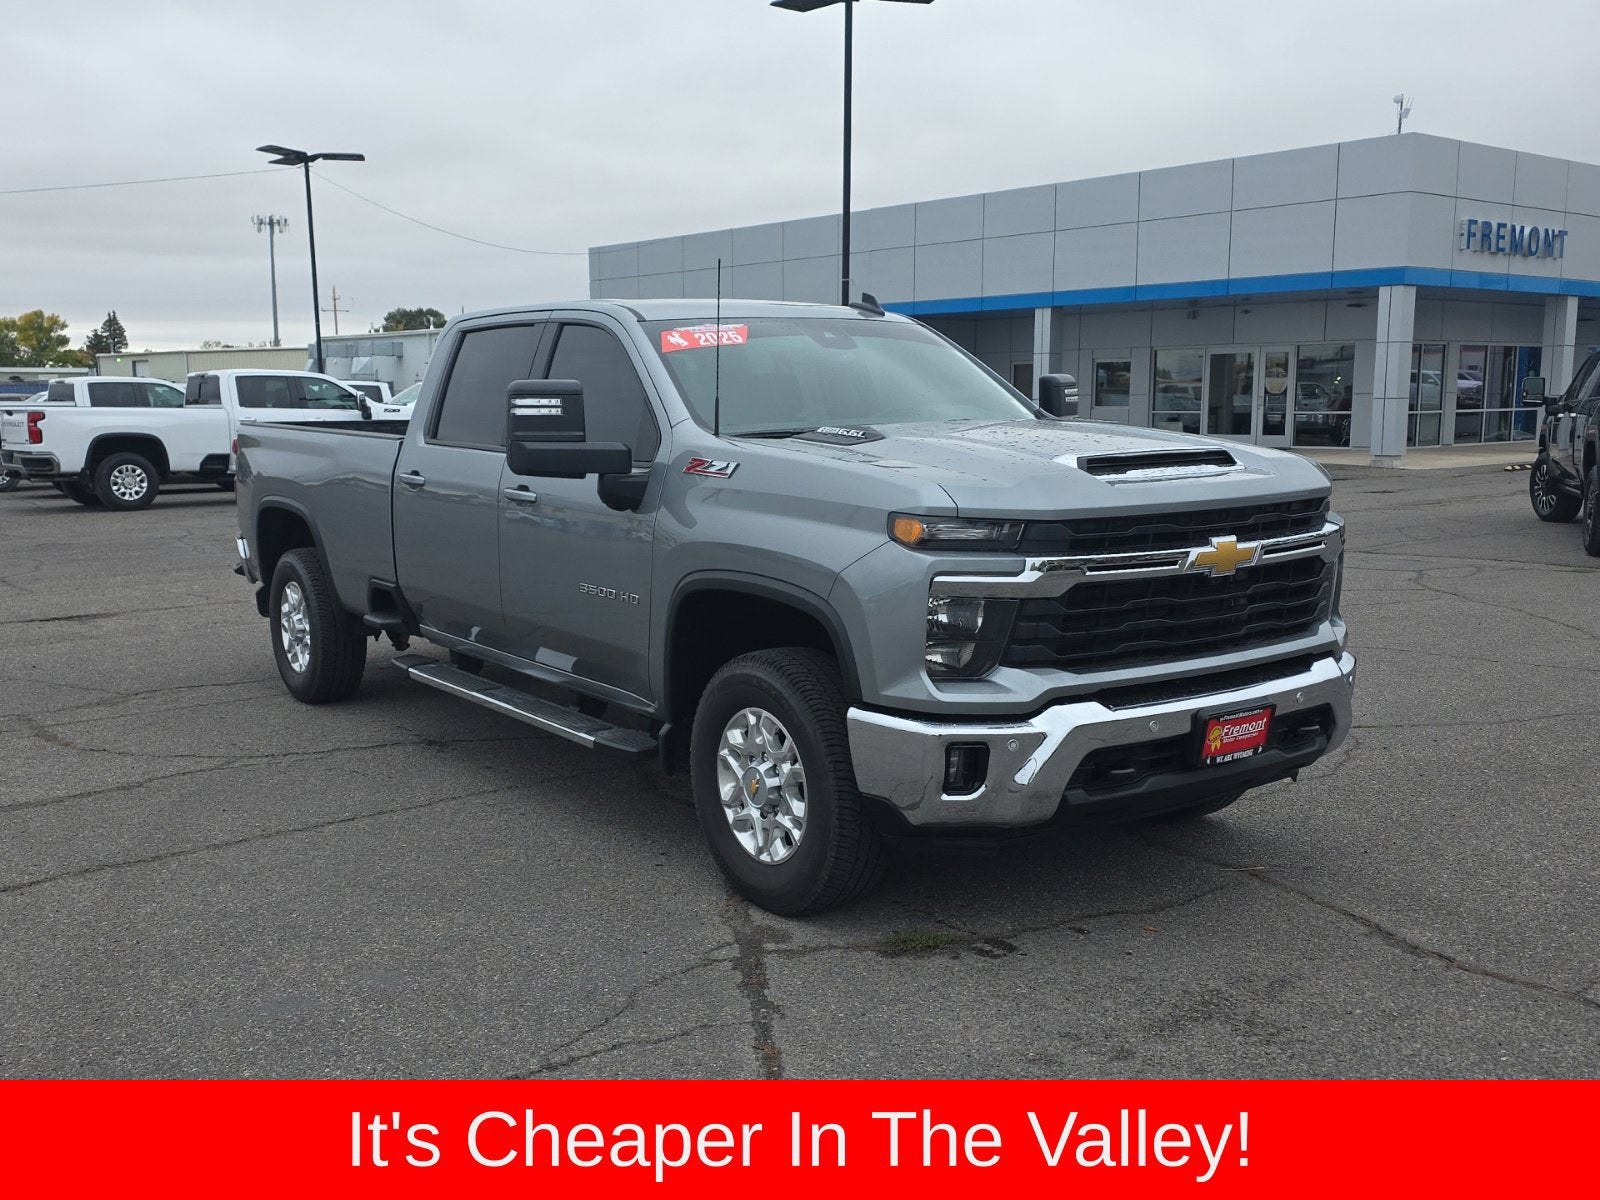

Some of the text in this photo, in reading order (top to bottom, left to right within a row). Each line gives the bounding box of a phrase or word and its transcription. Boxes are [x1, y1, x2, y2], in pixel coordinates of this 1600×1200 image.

[1464, 219, 1568, 259] FREMONT
[693, 331, 744, 346] 2025
[682, 456, 740, 479] Z71
[579, 582, 640, 605] 3500 HD
[1222, 717, 1267, 736] Fremont
